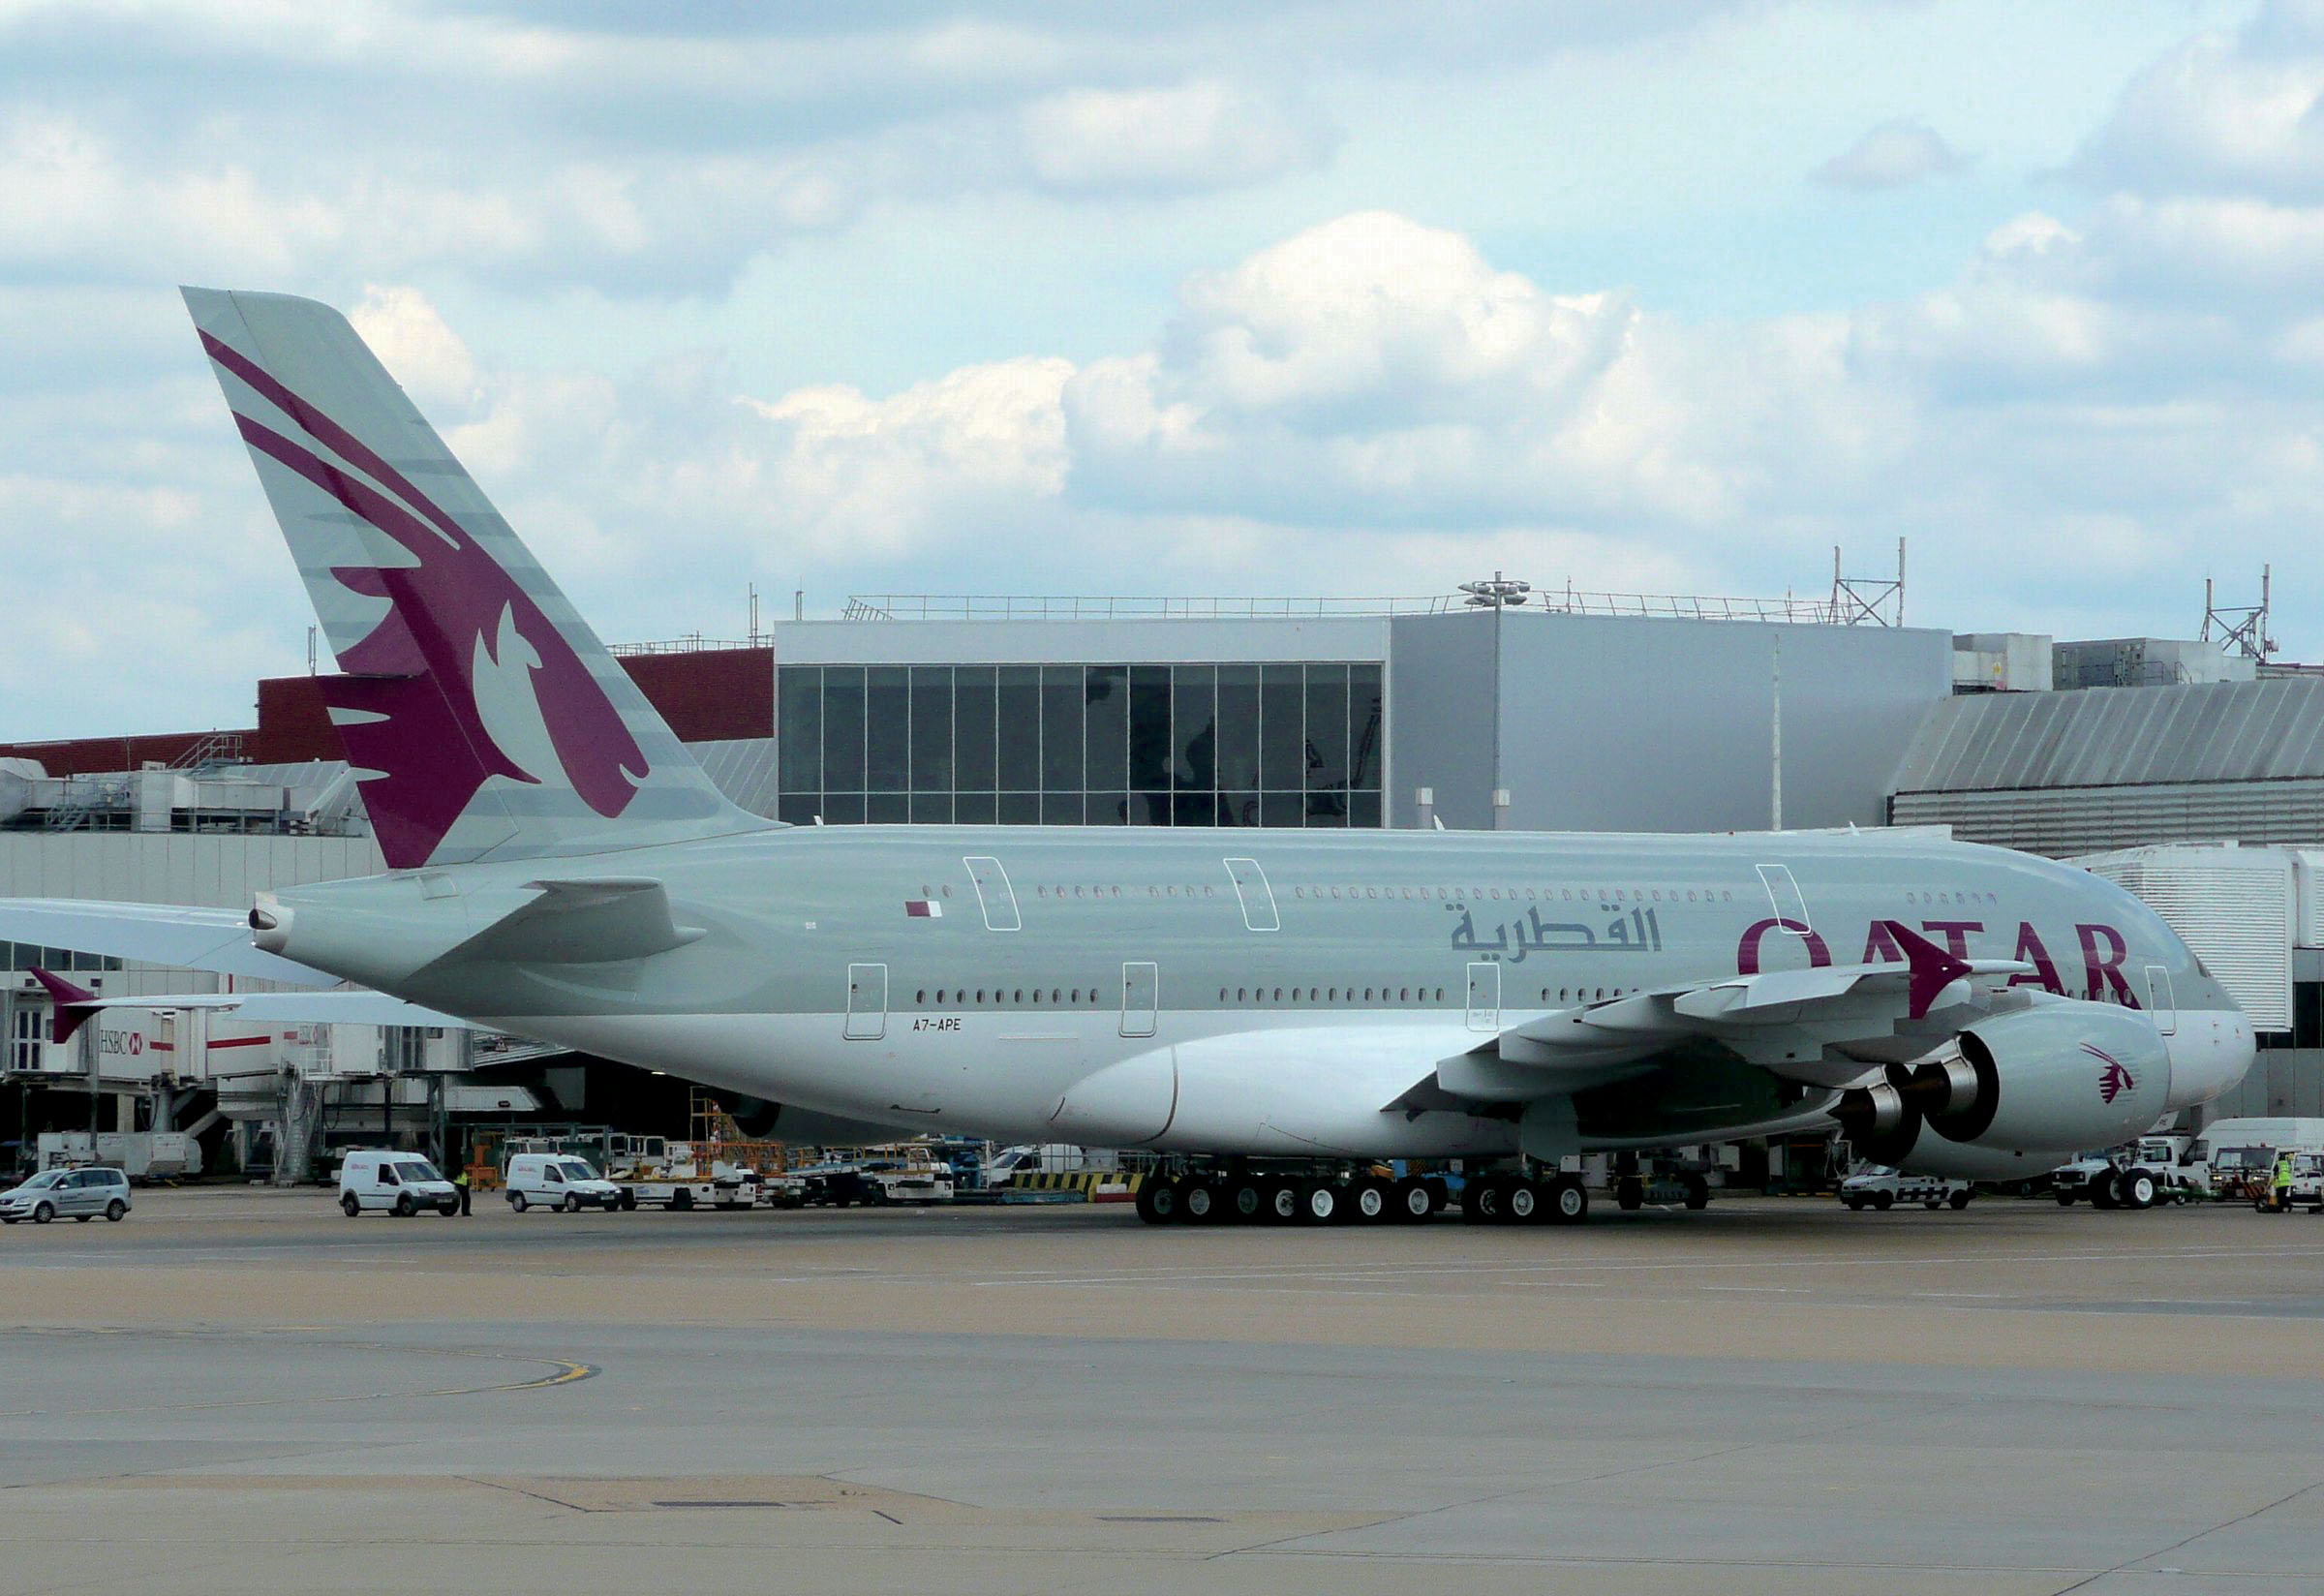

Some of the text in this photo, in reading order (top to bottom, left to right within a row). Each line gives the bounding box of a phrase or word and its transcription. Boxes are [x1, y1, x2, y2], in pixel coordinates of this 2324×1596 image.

[1446, 905, 1662, 964] القطرية
[912, 1018, 962, 1031] A7-APE
[100, 1028, 128, 1055] HSBC
